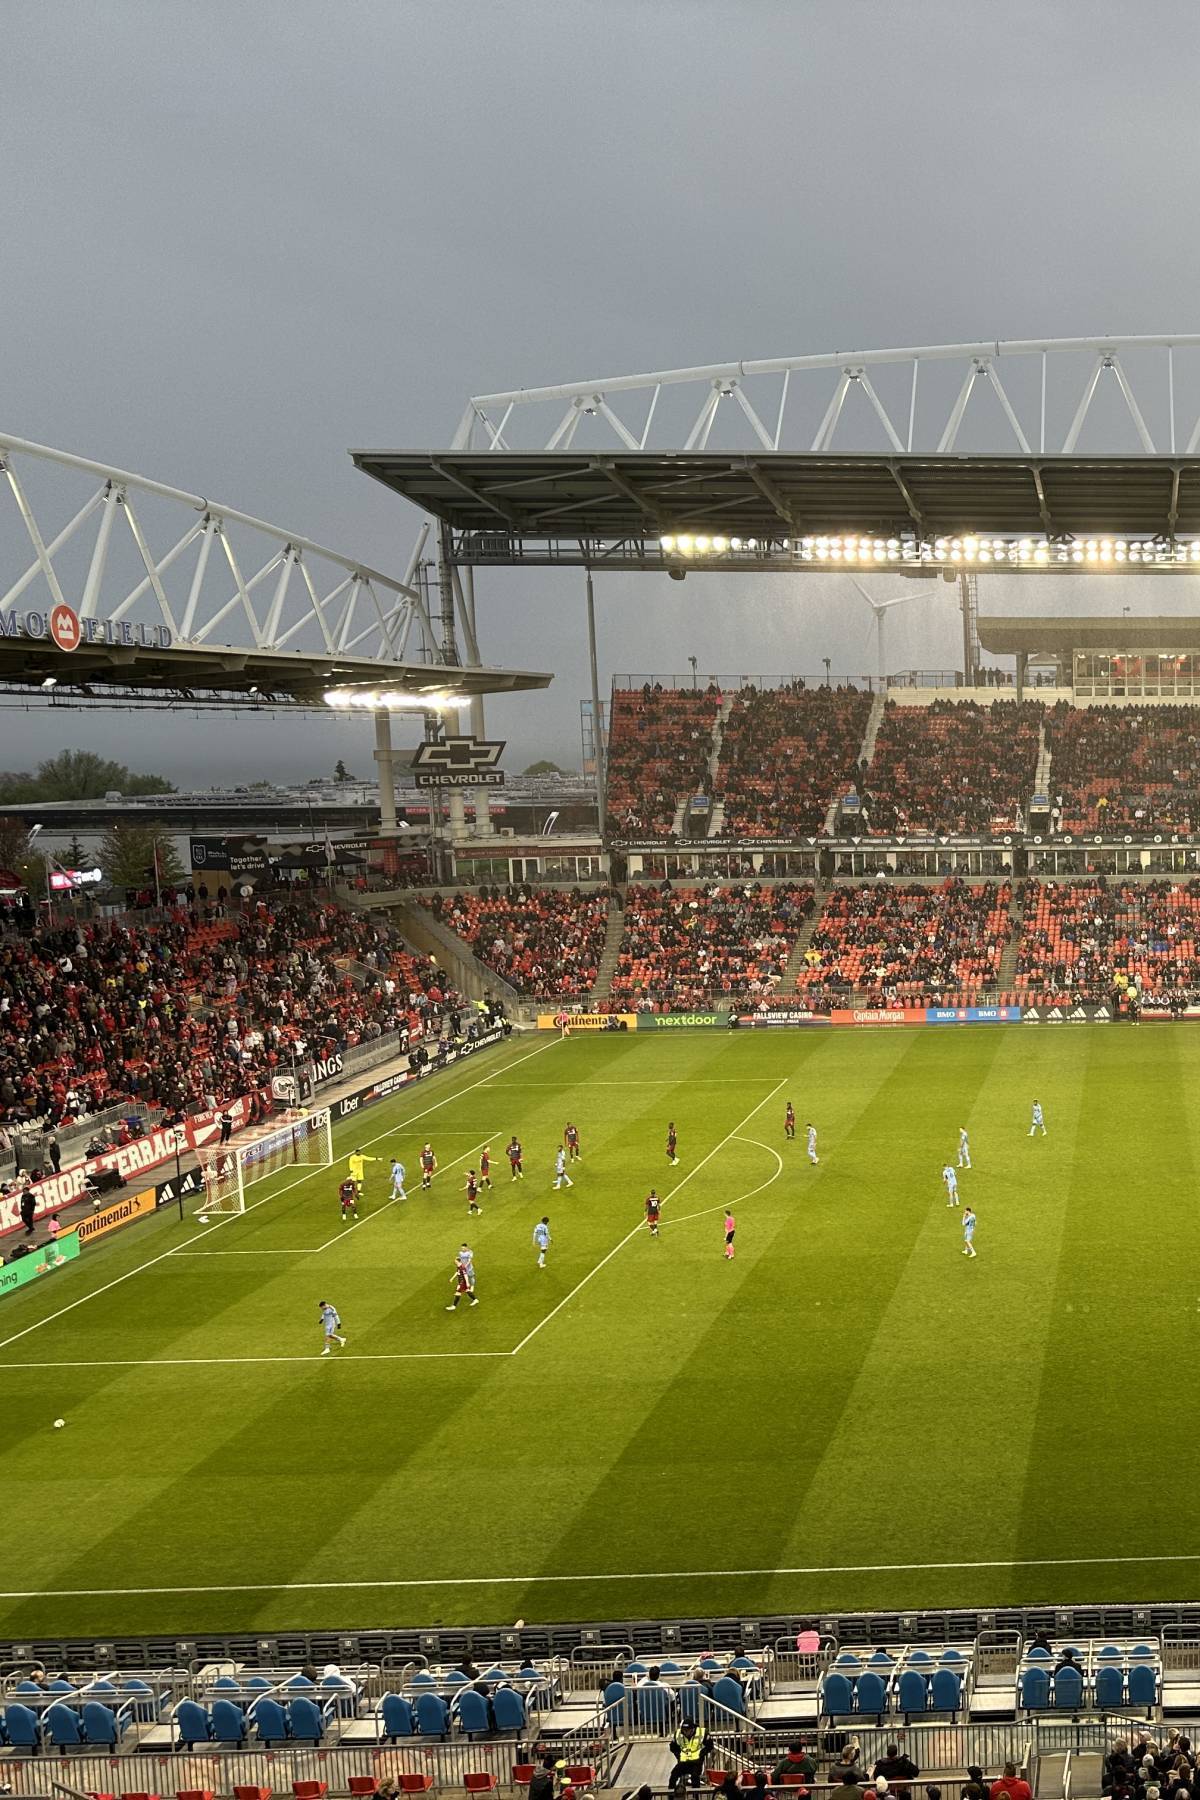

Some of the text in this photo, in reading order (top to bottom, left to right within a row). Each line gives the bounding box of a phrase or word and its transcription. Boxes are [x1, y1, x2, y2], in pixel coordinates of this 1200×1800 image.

[84, 617, 173, 649] FIELD
[419, 774, 502, 785] CHEVROLET
[230, 856, 263, 864] Together
[655, 1014, 717, 1026] nextdoor
[753, 1011, 813, 1020] FALLSVIEW CASINO
[853, 1010, 905, 1022] Captain Morgan
[474, 1030, 502, 1048] CHEVROLET
[340, 1097, 359, 1115] Uber
[102, 1123, 189, 1177] TERRACE
